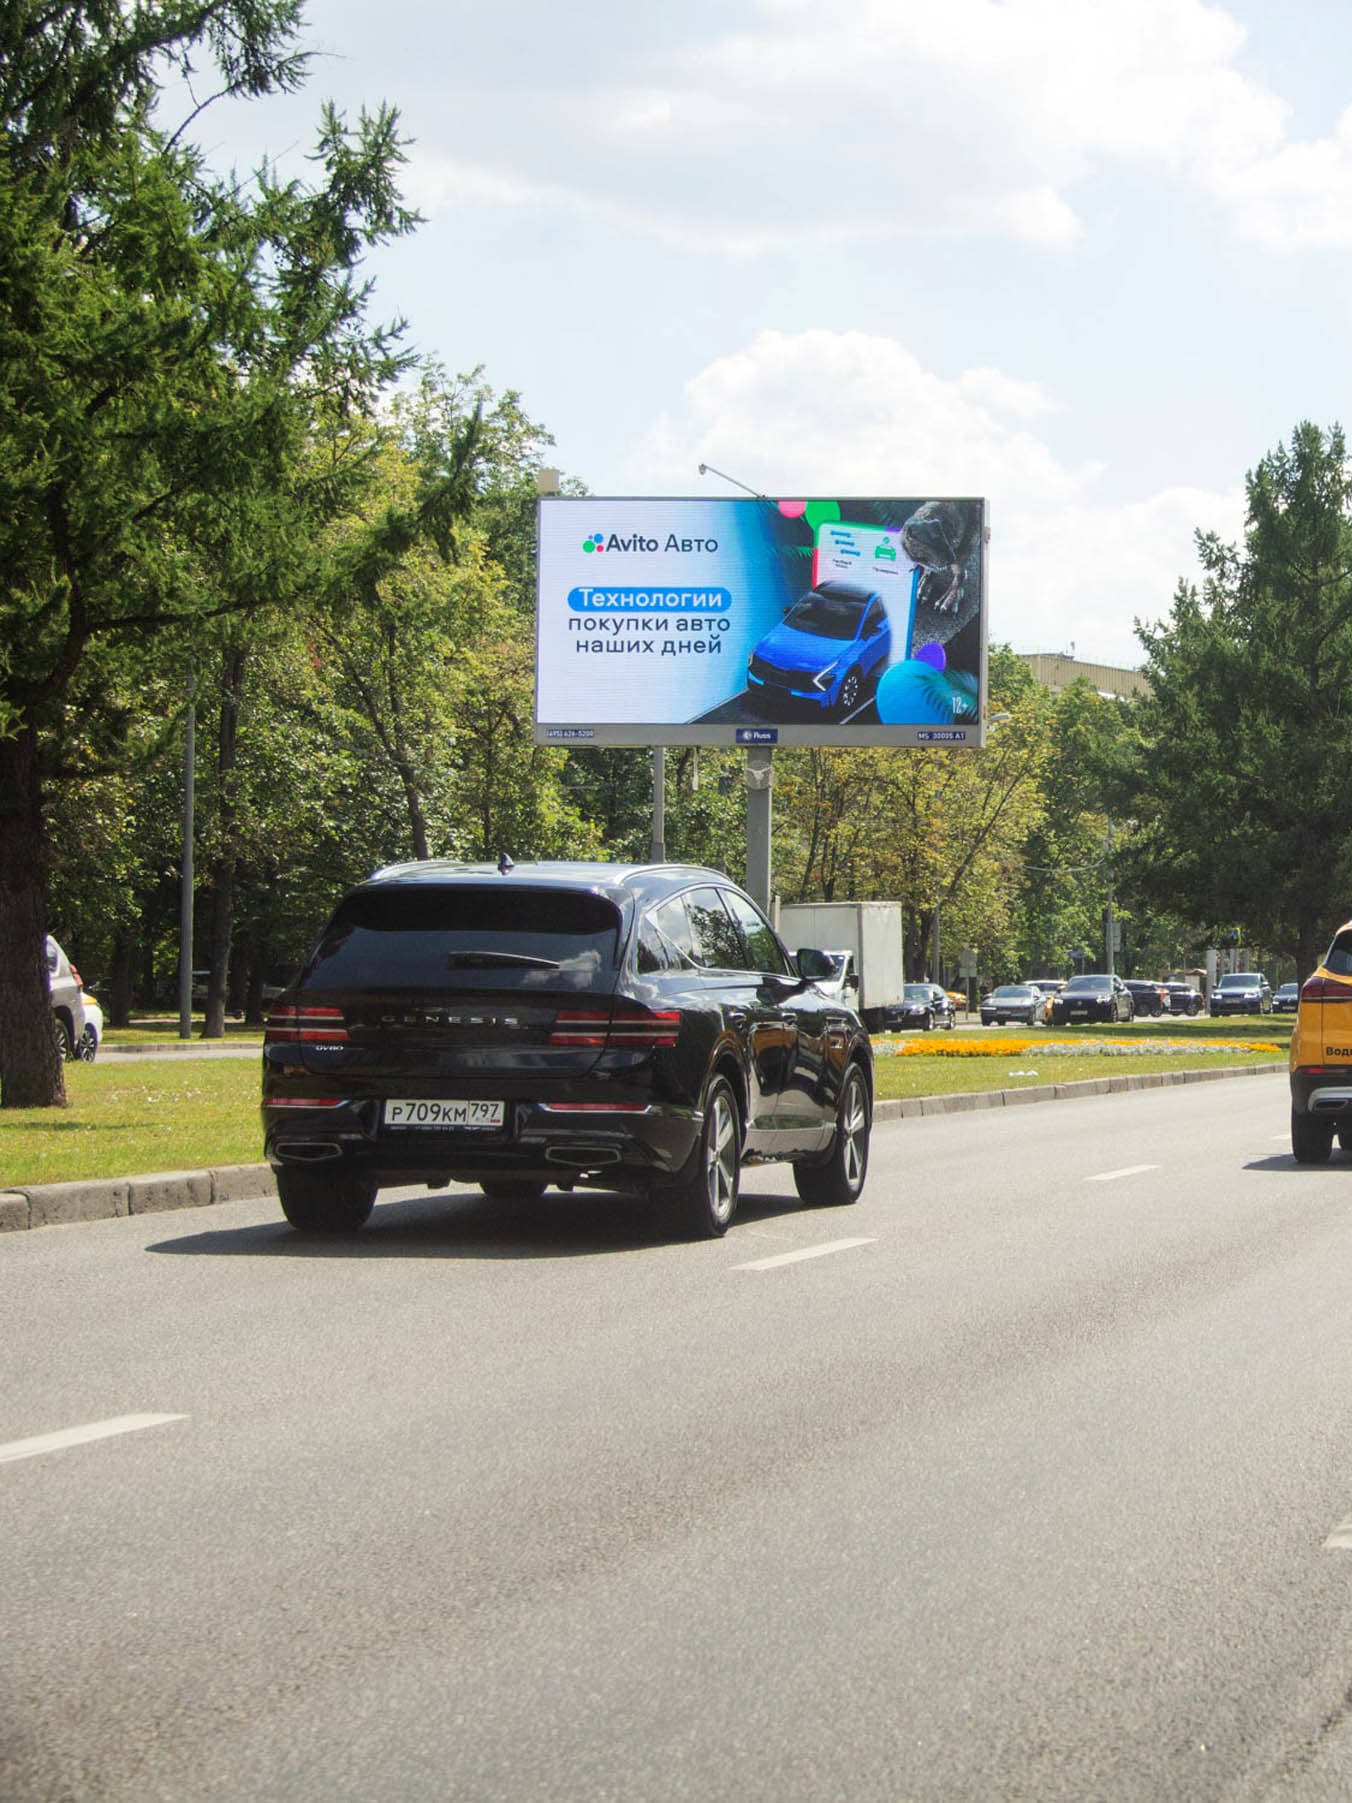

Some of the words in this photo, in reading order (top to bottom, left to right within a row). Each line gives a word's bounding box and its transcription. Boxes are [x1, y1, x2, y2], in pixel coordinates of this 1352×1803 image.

[606, 533, 659, 552] Avito
[664, 533, 718, 552] Авто
[578, 588, 722, 607] Технологии
[568, 617, 668, 636] покупки
[676, 617, 731, 631] авто
[576, 639, 655, 654] наших
[661, 633, 722, 657] дней
[952, 696, 968, 714] 12+
[381, 1015, 519, 1025] GENESIS
[470, 1102, 499, 1118] 797
